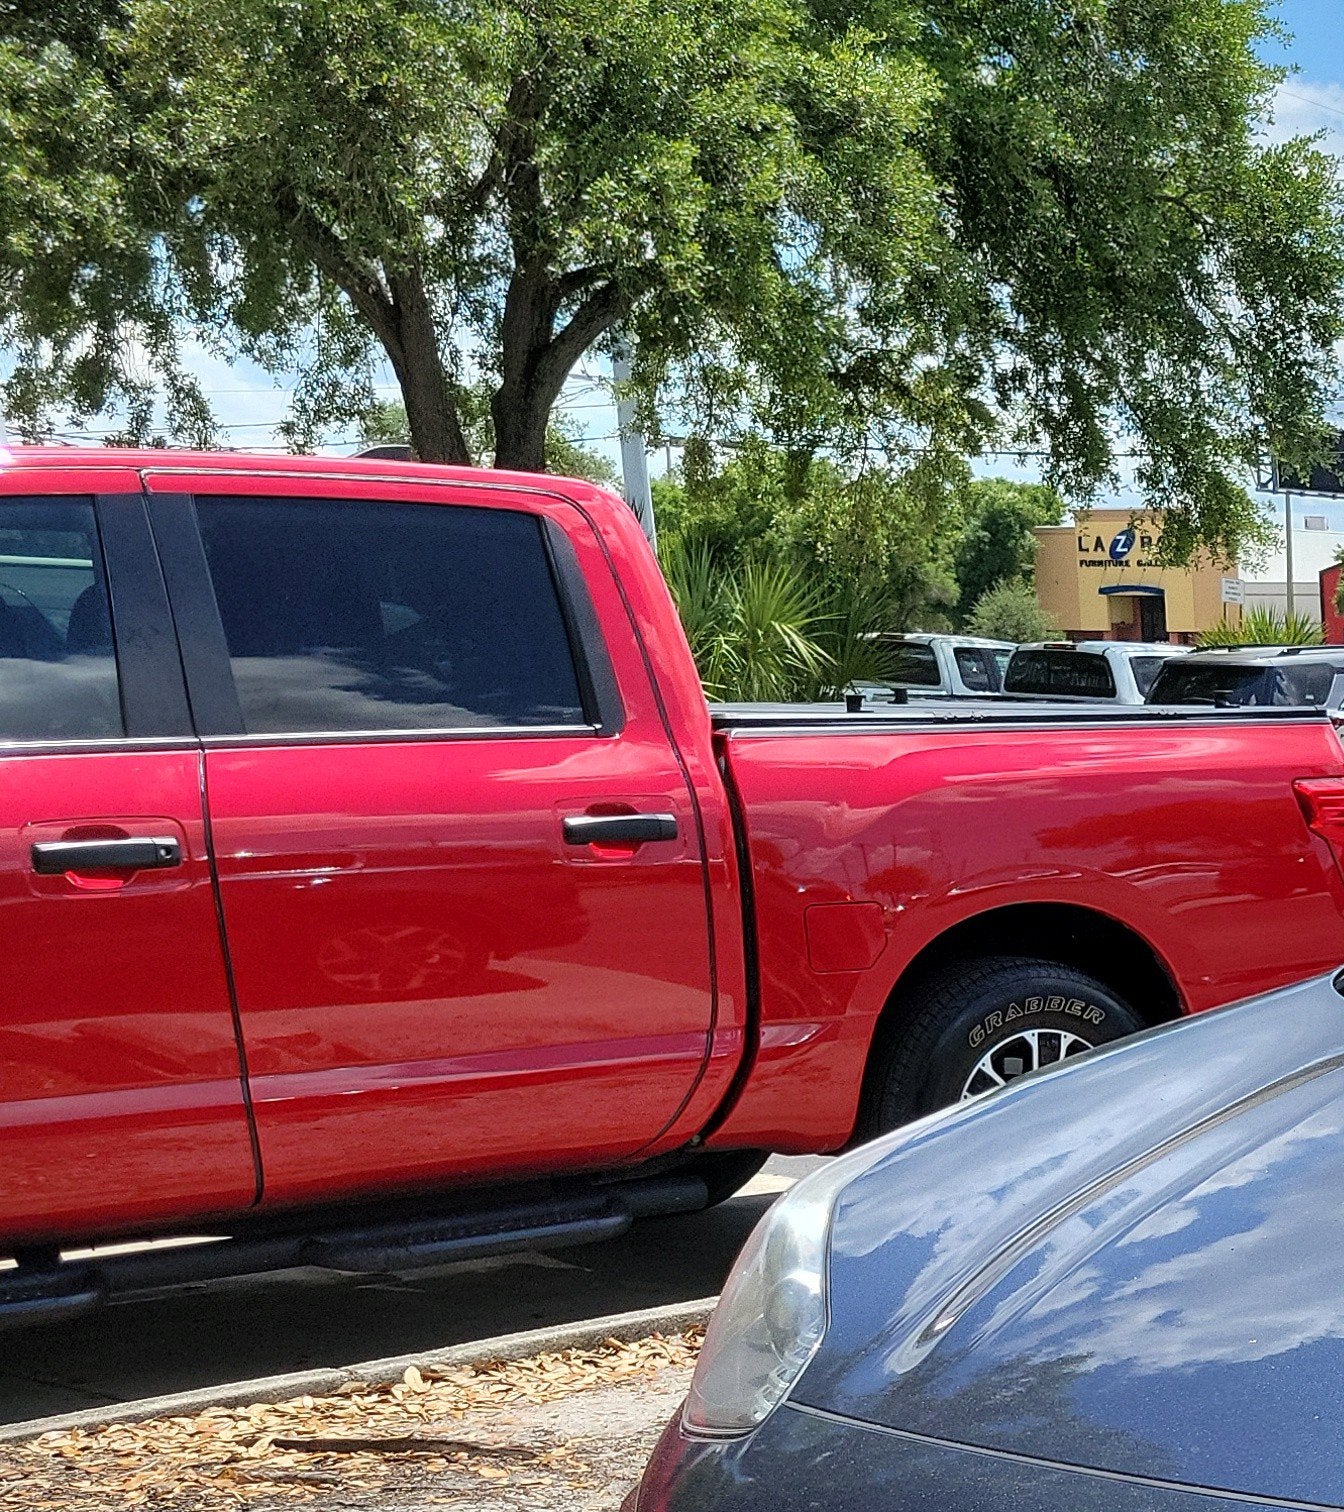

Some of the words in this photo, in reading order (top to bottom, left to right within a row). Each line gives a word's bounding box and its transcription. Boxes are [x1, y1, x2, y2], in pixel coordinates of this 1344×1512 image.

[1078, 535, 1106, 552] LA
[1115, 535, 1128, 552] Z
[1079, 559, 1130, 568] FURNITURE
[968, 995, 1106, 1048] GRABBER
